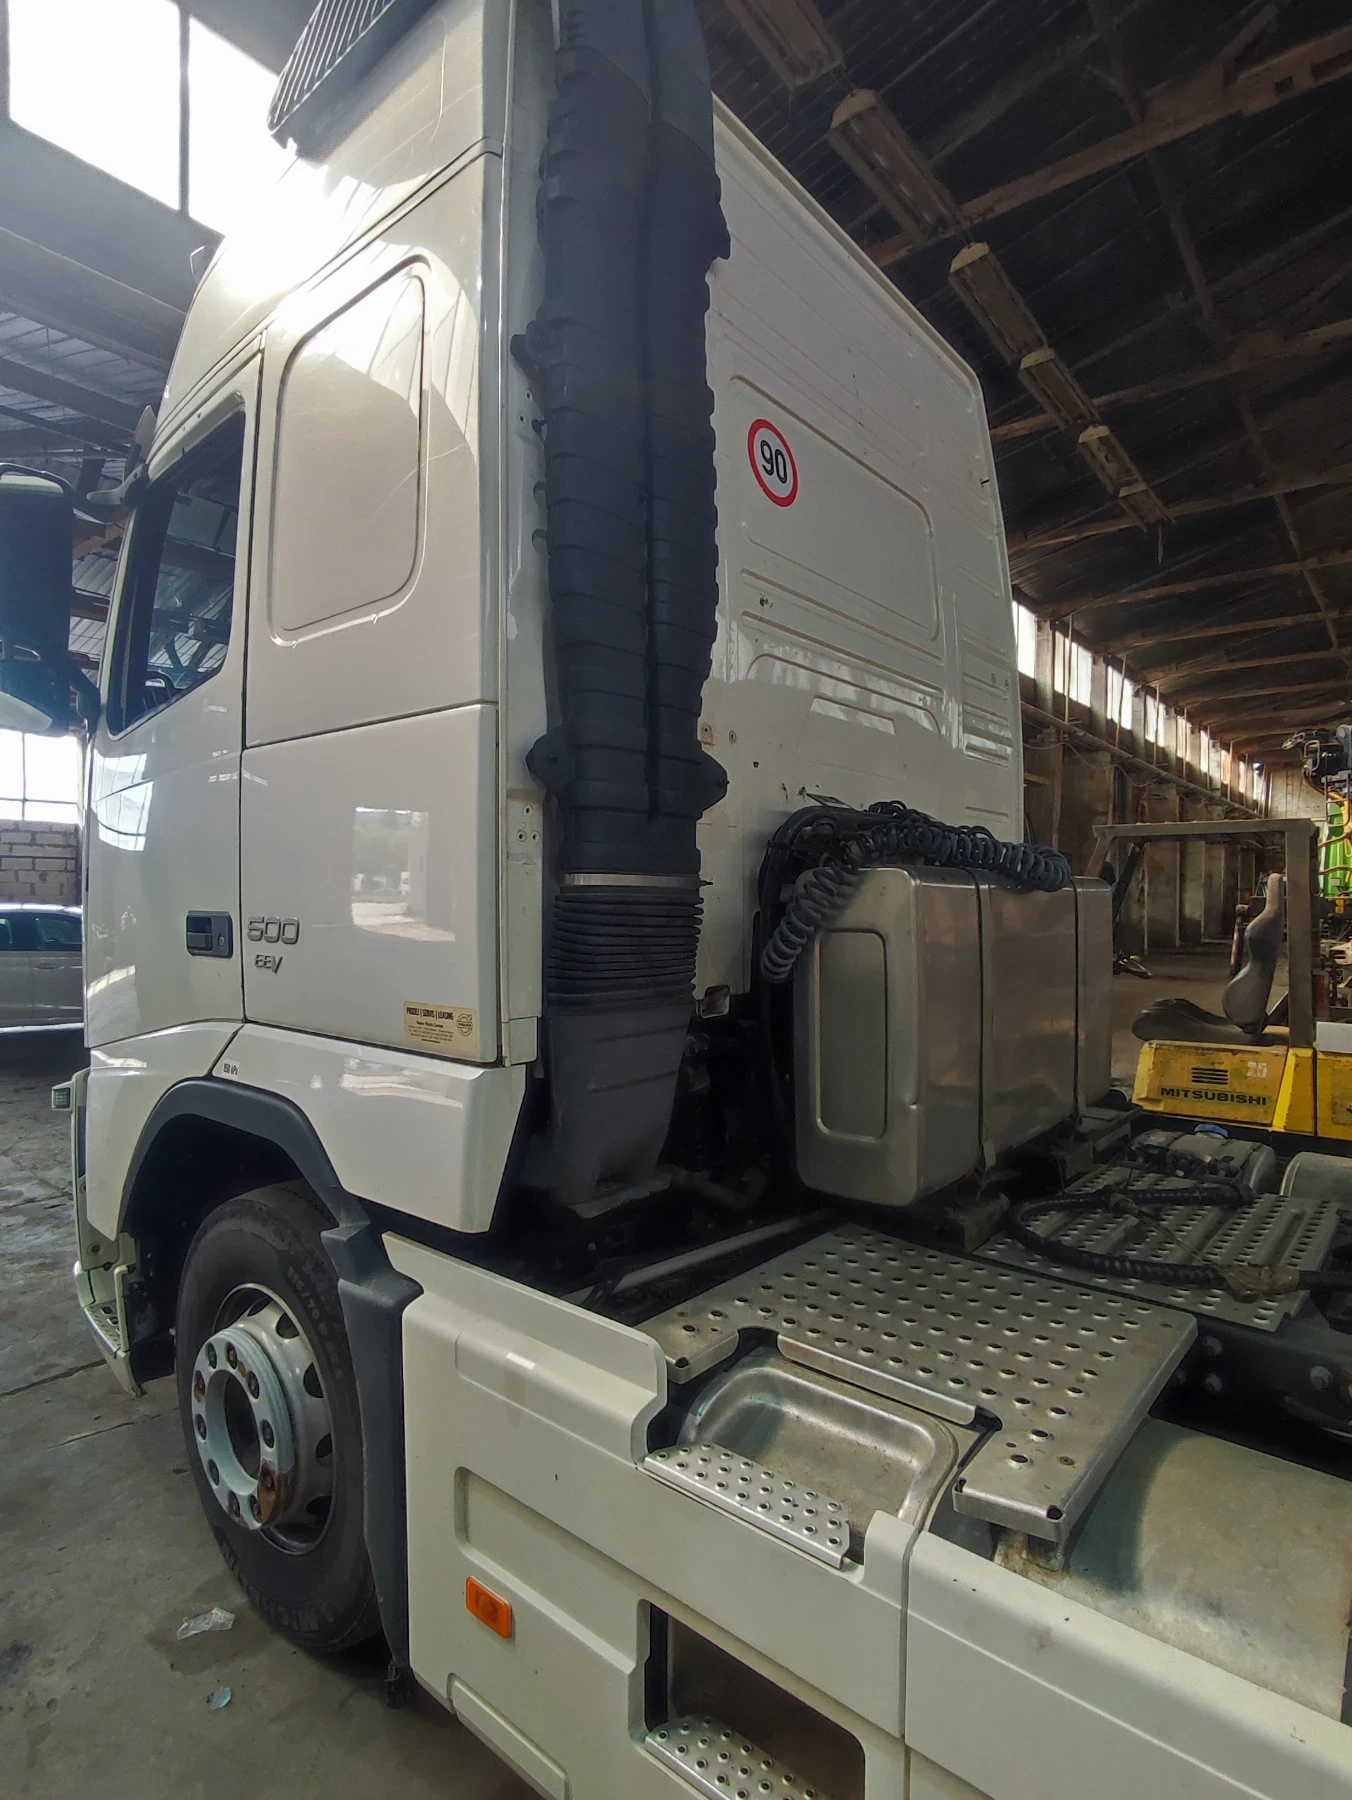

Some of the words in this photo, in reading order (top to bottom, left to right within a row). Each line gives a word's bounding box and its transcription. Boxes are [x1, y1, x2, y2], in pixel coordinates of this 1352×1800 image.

[760, 439, 788, 484] 90
[247, 916, 300, 945] 500
[254, 954, 283, 974] EEV
[1160, 1087, 1267, 1106] MITSUBISHI
